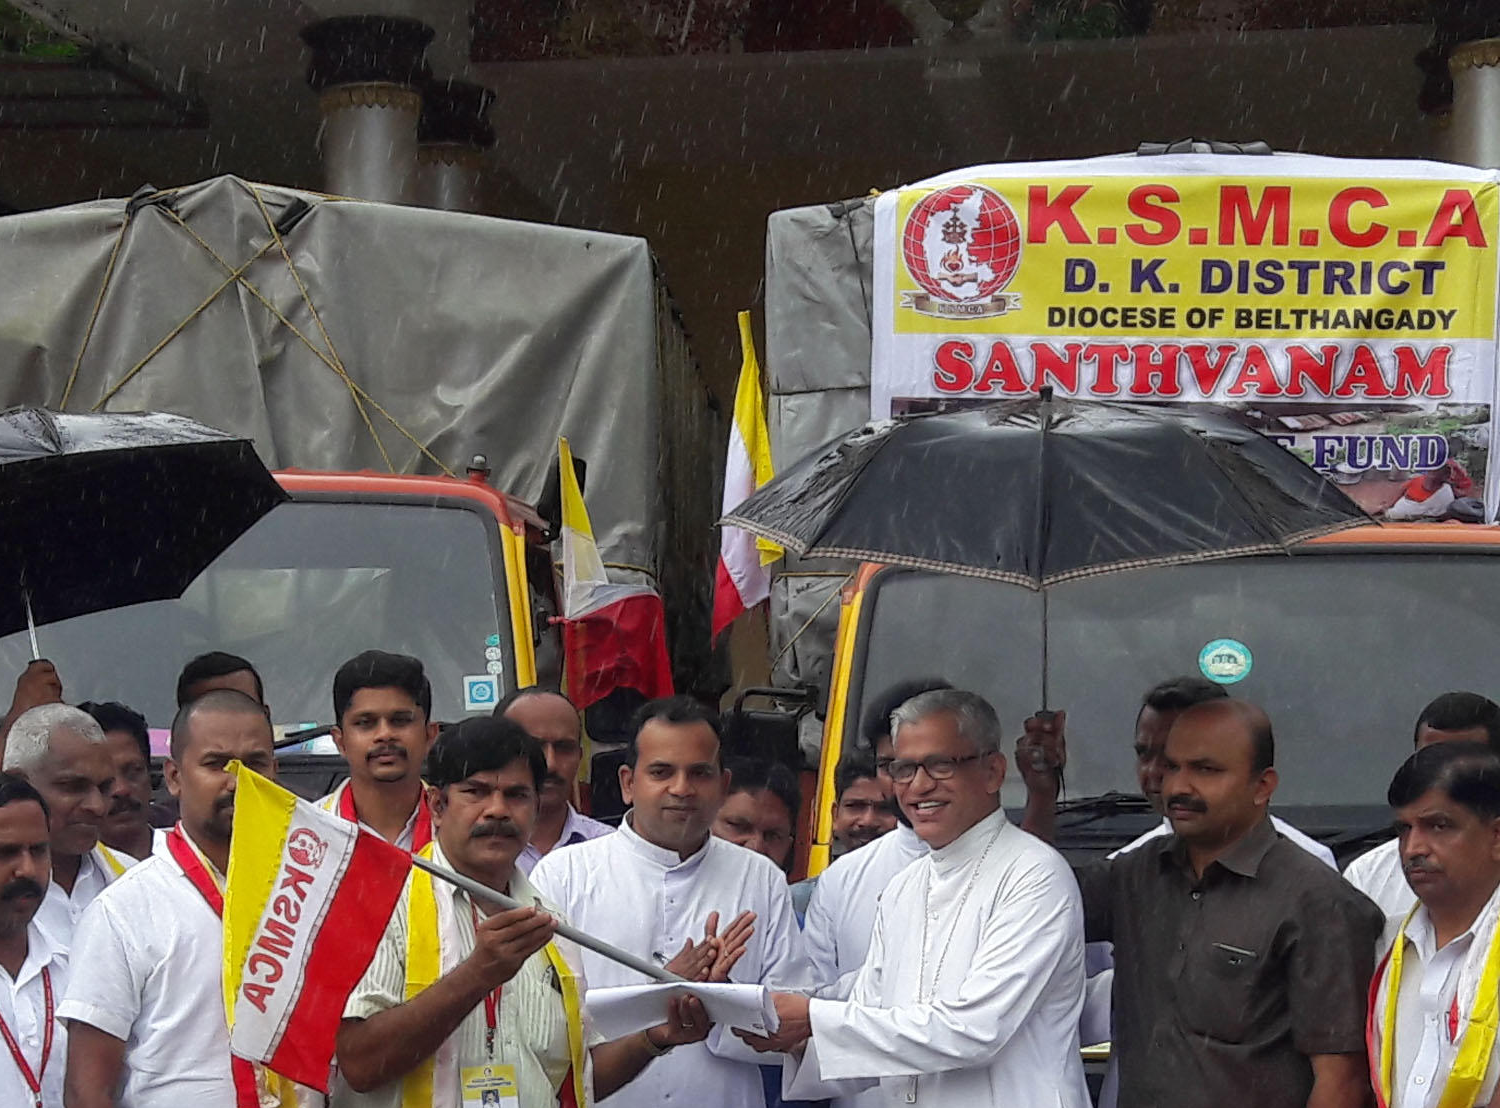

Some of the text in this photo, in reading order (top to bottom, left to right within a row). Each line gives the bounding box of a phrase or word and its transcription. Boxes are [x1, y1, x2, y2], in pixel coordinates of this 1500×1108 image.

[1026, 184, 1489, 249] K.S.M.C.A
[1064, 257, 1446, 296] D. K. DISTRICT
[1047, 305, 1458, 331] DIOCESE OF BELTHANGADY
[932, 340, 1453, 398] SANTHVANAM
[1311, 435, 1449, 469] FUND
